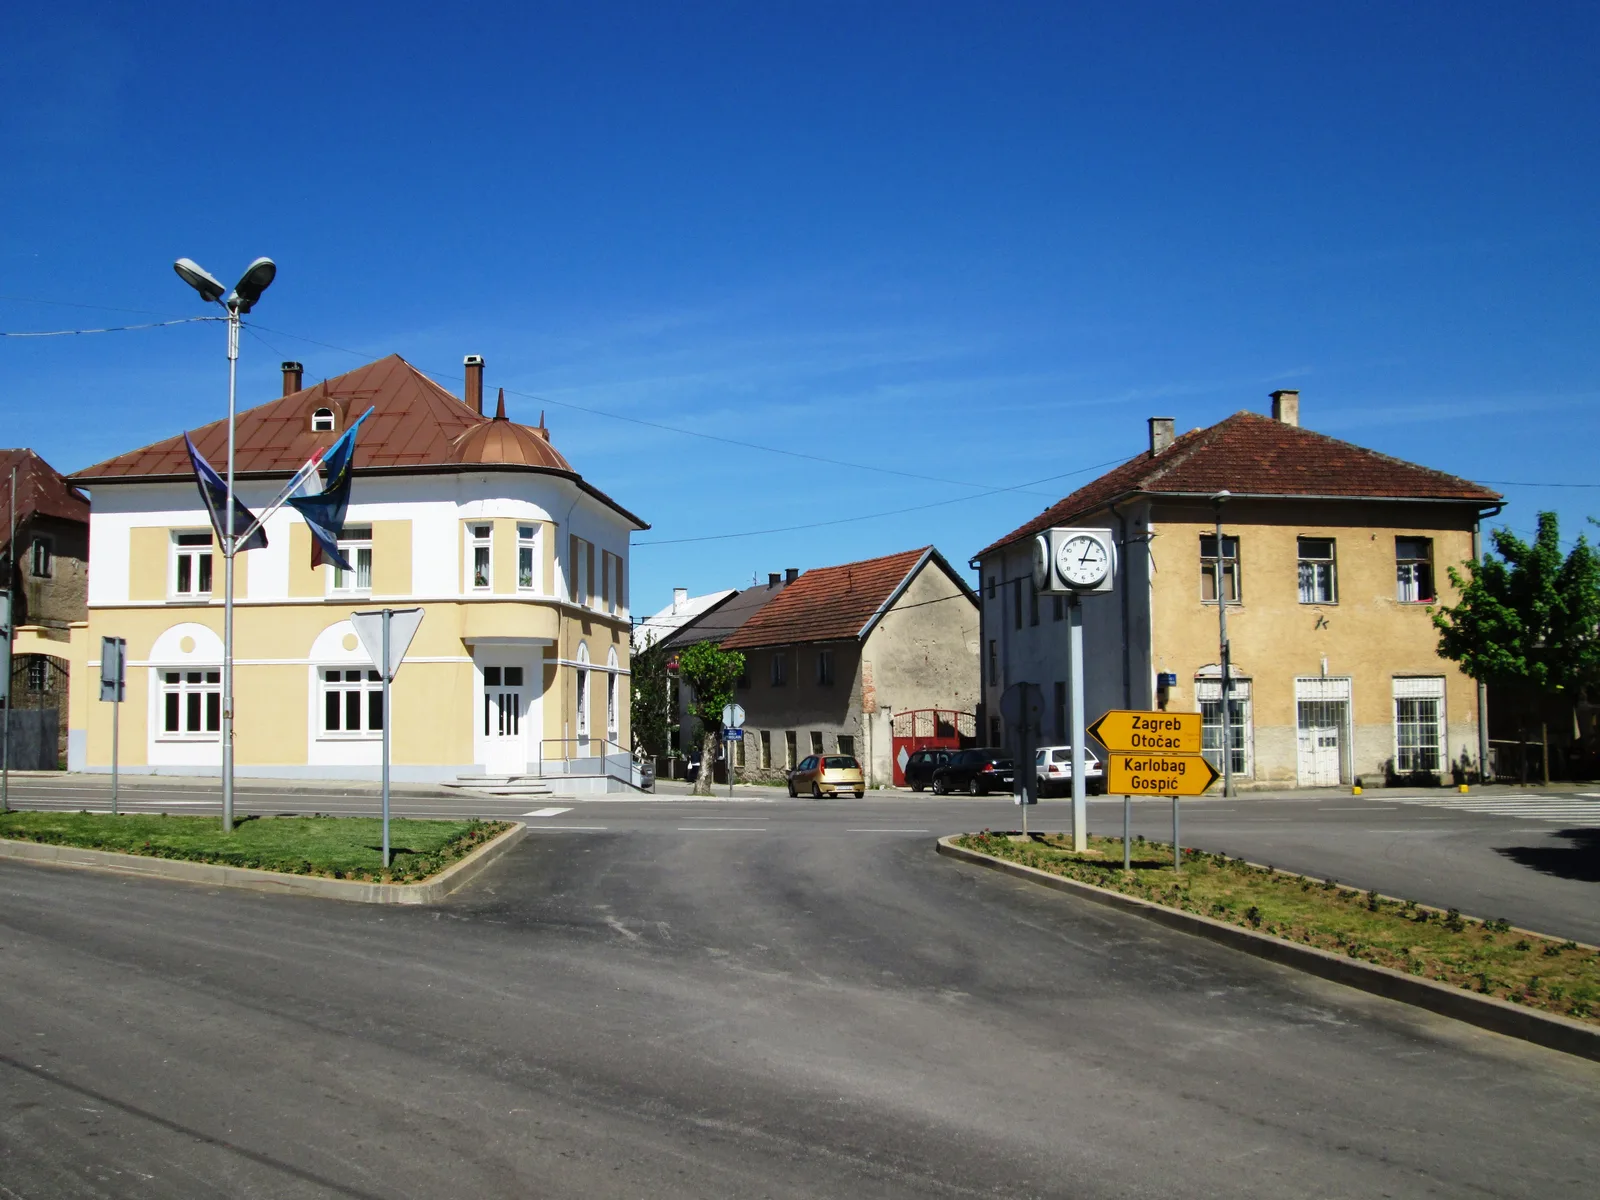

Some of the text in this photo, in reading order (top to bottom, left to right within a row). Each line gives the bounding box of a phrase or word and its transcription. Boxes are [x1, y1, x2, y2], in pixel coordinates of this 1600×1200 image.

[1132, 716, 1181, 733] Zagreb
[1131, 734, 1181, 748] Otočac
[1124, 758, 1186, 775] Karlobag
[1131, 776, 1178, 792] Gospić
